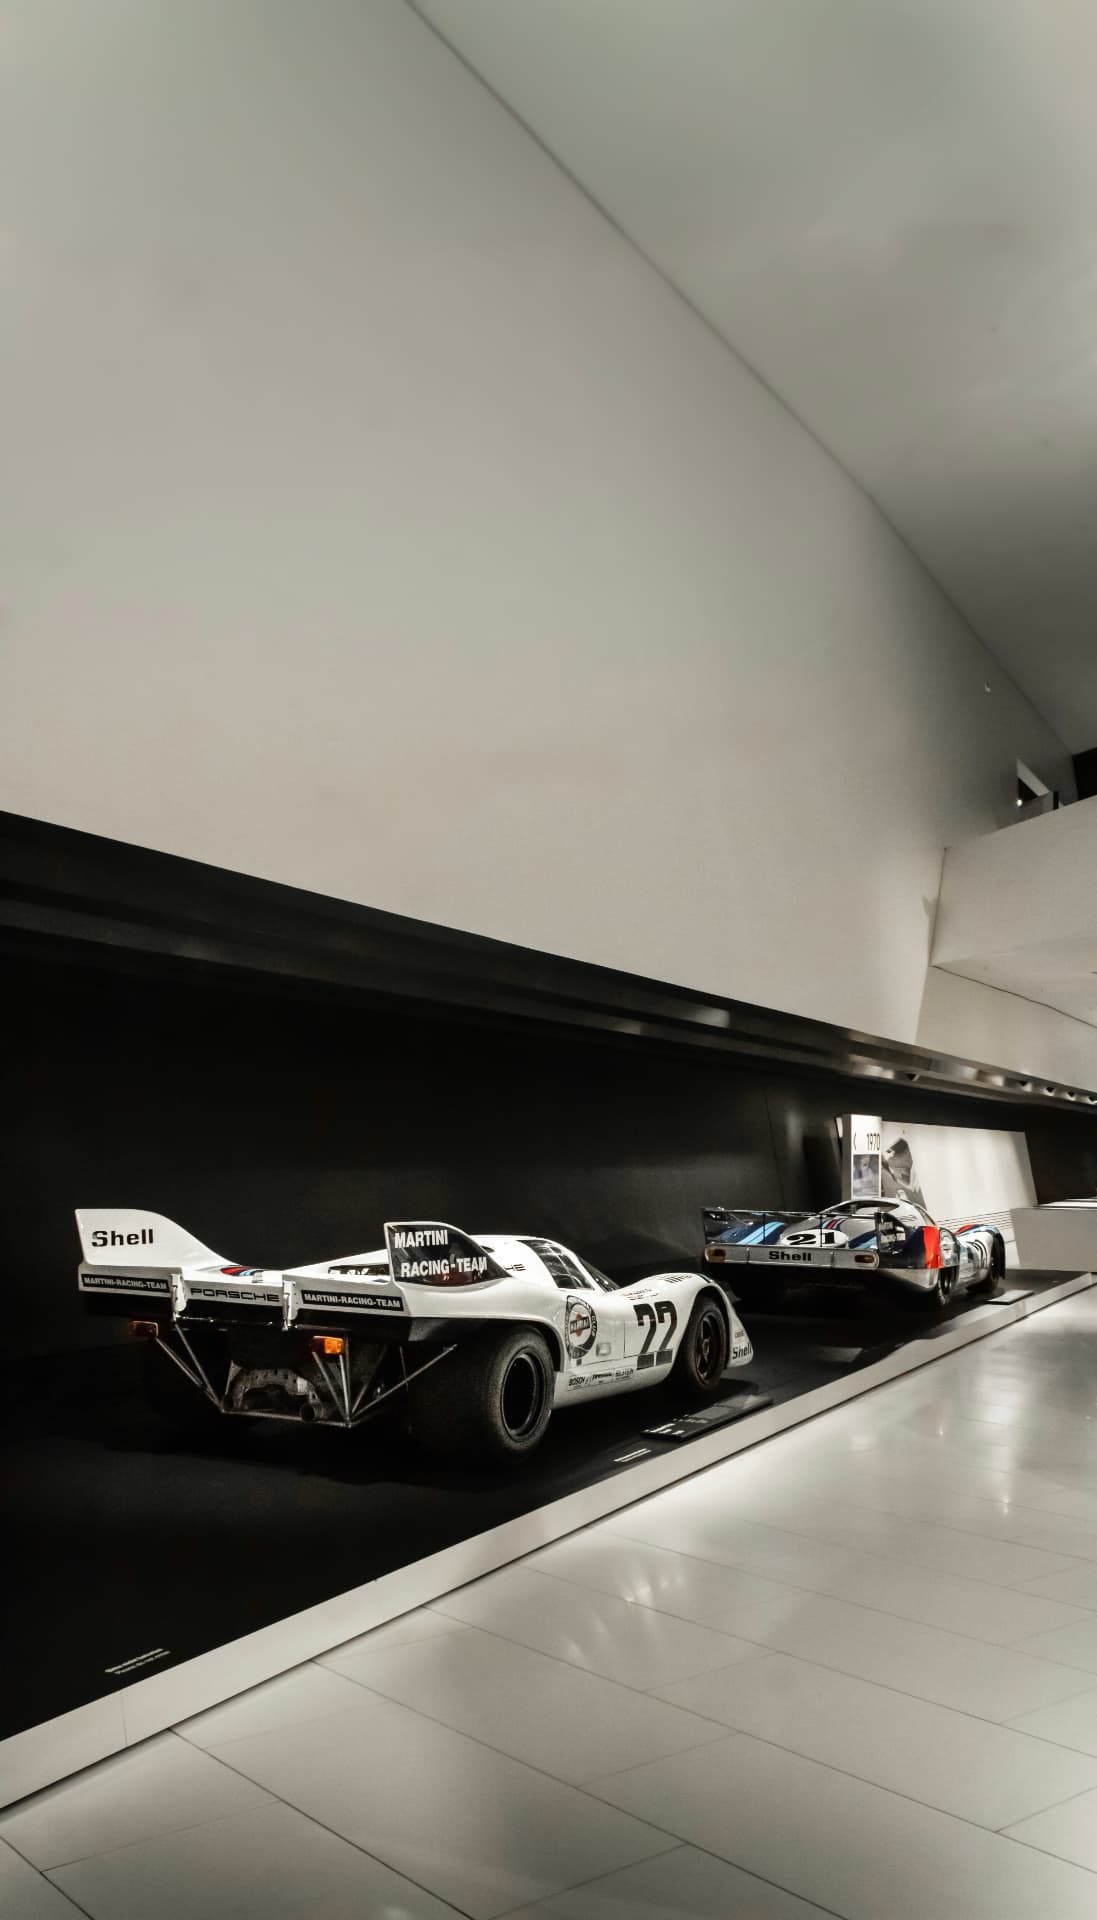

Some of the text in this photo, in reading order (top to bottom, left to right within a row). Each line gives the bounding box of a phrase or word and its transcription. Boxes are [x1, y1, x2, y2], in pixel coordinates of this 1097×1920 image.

[867, 1132, 880, 1151] 1970
[91, 1229, 154, 1247] Shell
[394, 1230, 448, 1248] MARTINI
[786, 1231, 836, 1246] 21
[768, 1250, 812, 1262] Shell
[401, 1257, 488, 1277] RACING-TEAM
[83, 1276, 168, 1291] MARTINI-RACING-TEAM
[190, 1288, 281, 1303] PORSCHE
[304, 1293, 401, 1308] MARTINI-RACING-TEAM
[633, 1300, 678, 1370] 22
